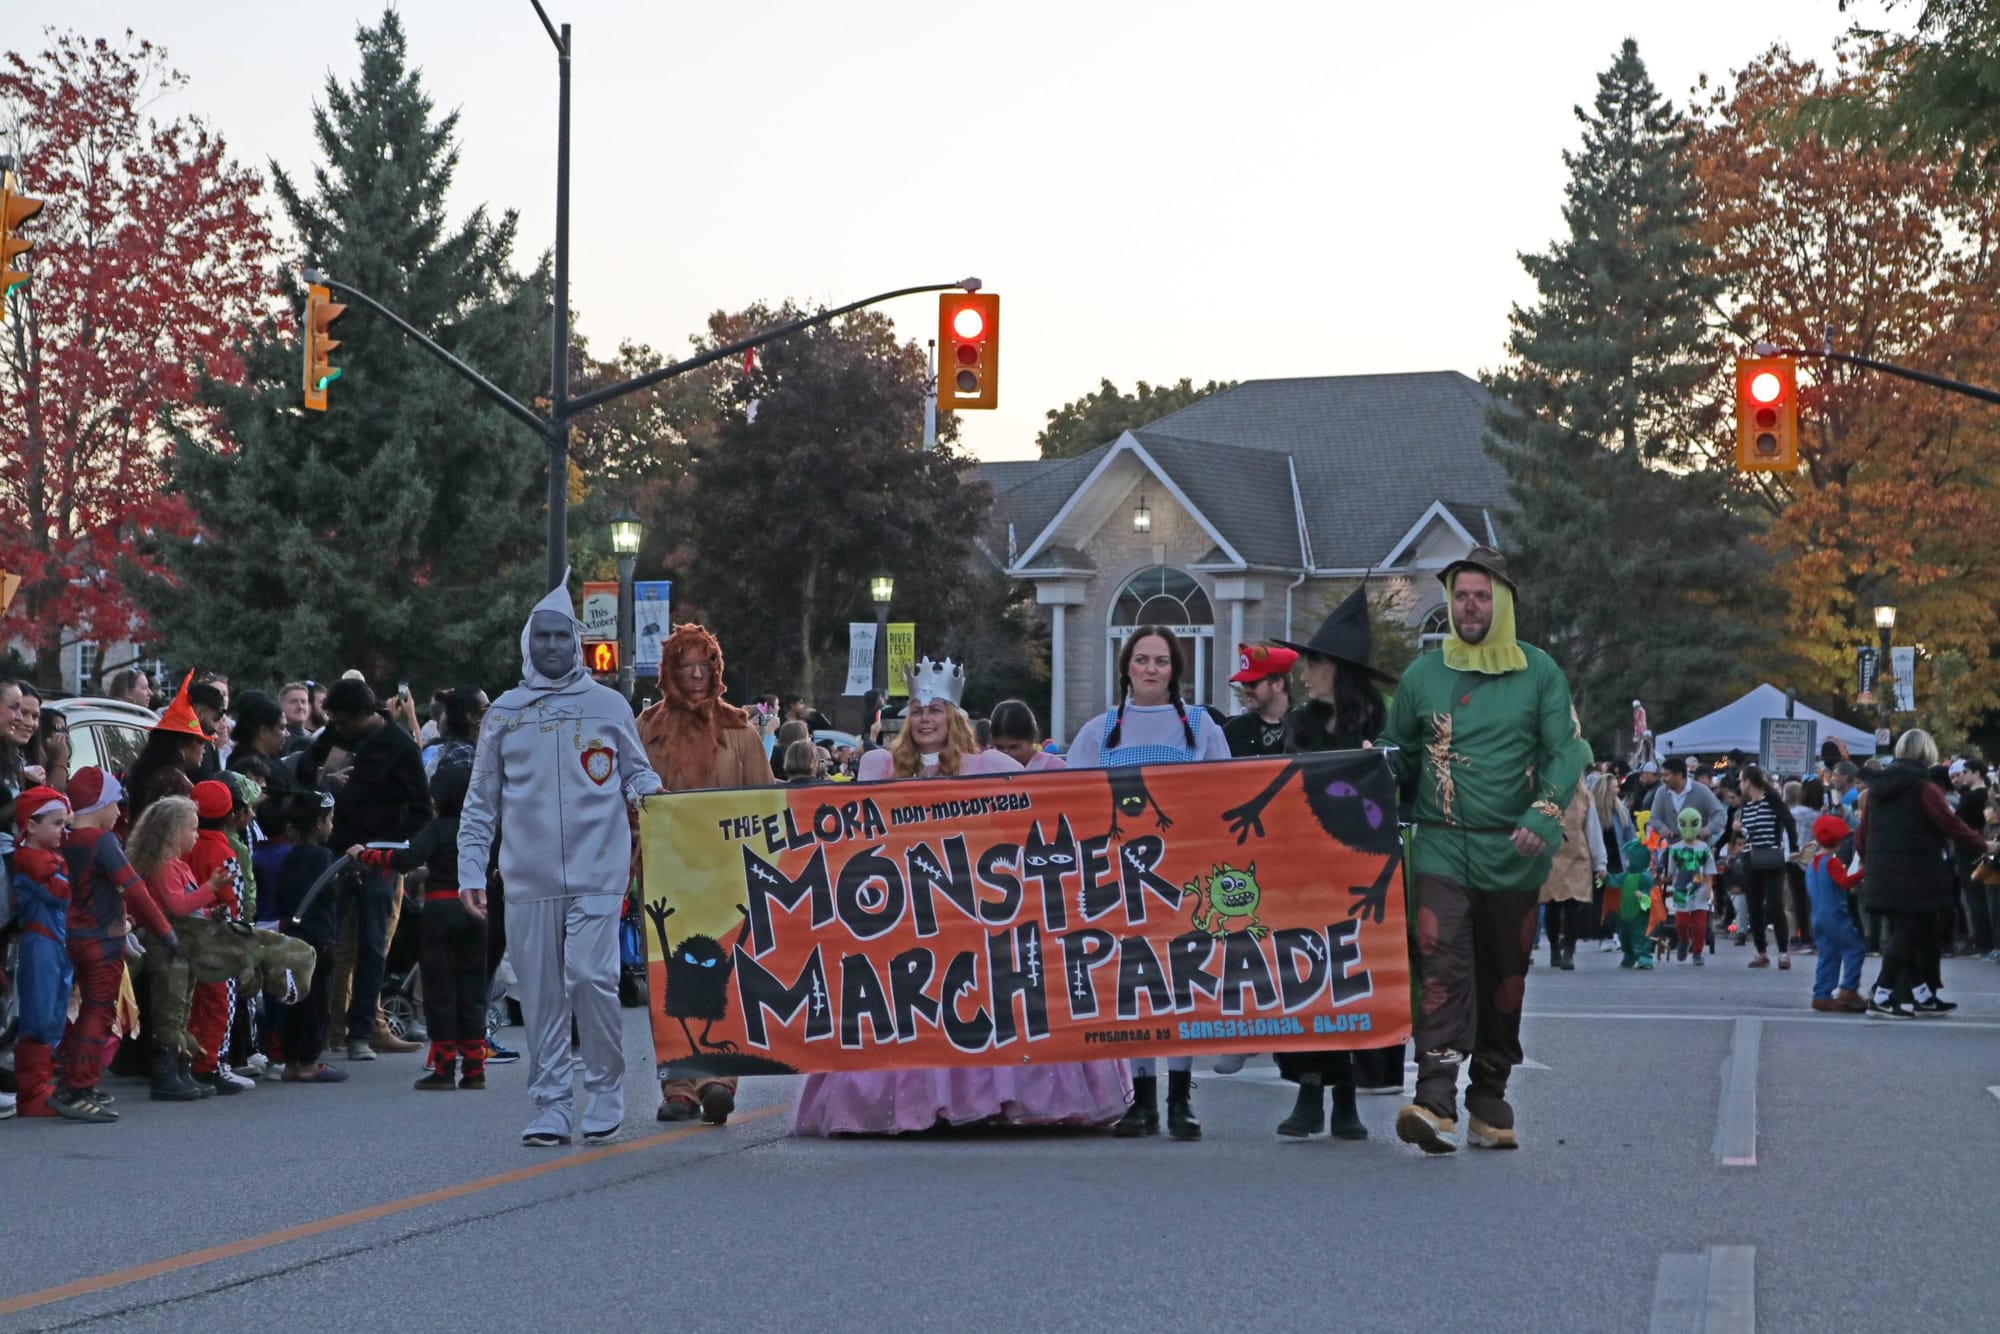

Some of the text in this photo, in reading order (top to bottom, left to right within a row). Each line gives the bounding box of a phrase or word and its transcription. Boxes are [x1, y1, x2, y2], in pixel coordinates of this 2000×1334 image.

[590, 608, 609, 618] This
[889, 632, 913, 643] RIVER
[849, 647, 873, 668] ELORA
[889, 644, 906, 655] FEST
[718, 814, 762, 841] THE
[763, 797, 888, 854] ELORA
[741, 813, 1183, 961] MONSTER
[732, 918, 1374, 1054] MARCH PARADE
